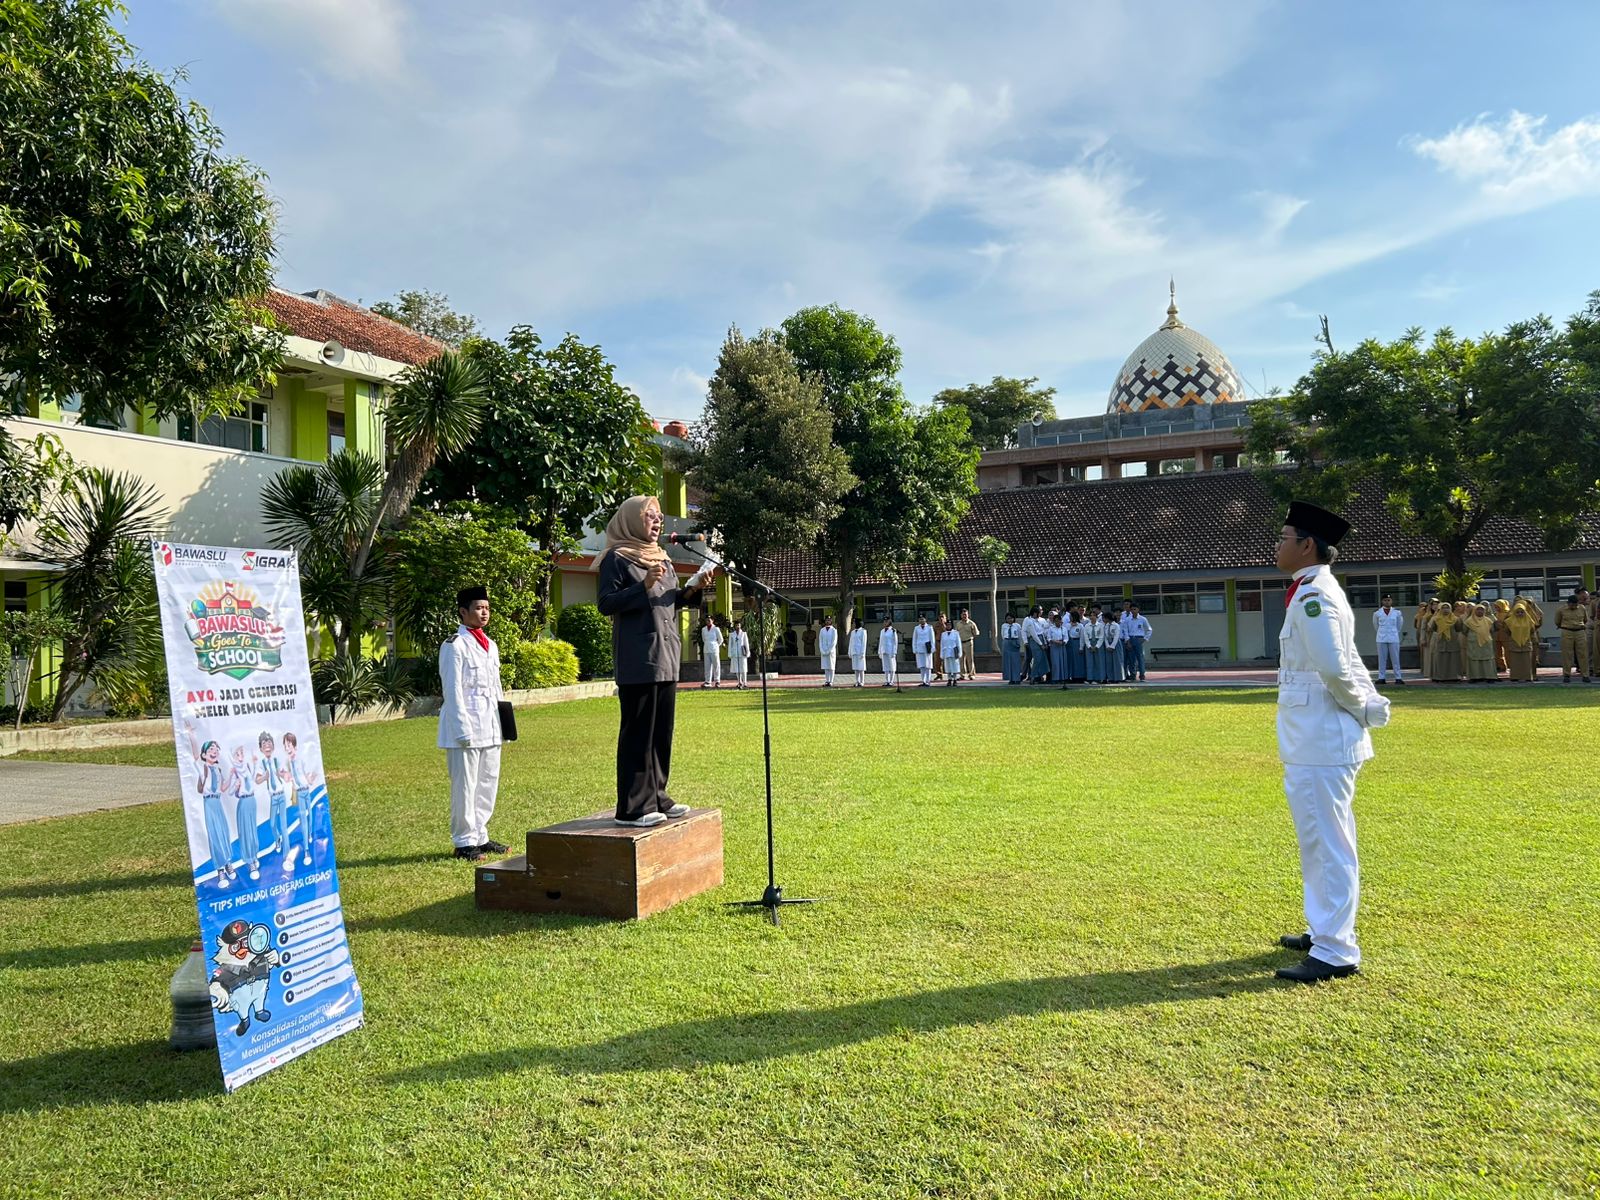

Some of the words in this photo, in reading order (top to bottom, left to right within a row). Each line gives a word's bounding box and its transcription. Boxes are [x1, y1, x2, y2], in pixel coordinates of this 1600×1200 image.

[175, 548, 227, 561] BAWASLU
[197, 615, 266, 636] BAWASLU
[211, 633, 237, 650] Goes
[237, 634, 252, 647] To
[208, 649, 264, 668] SCHOOL
[187, 689, 217, 703] AYO,
[220, 688, 245, 701] JADI
[248, 684, 297, 699] GENERASI
[194, 704, 230, 719] MELEK
[232, 698, 295, 716] DEMOKRASI!
[235, 888, 268, 907] MENJADI
[270, 878, 304, 897] GENERASI
[251, 1019, 297, 1045] Konsolidasi
[241, 1033, 290, 1061] Mewujudkan
